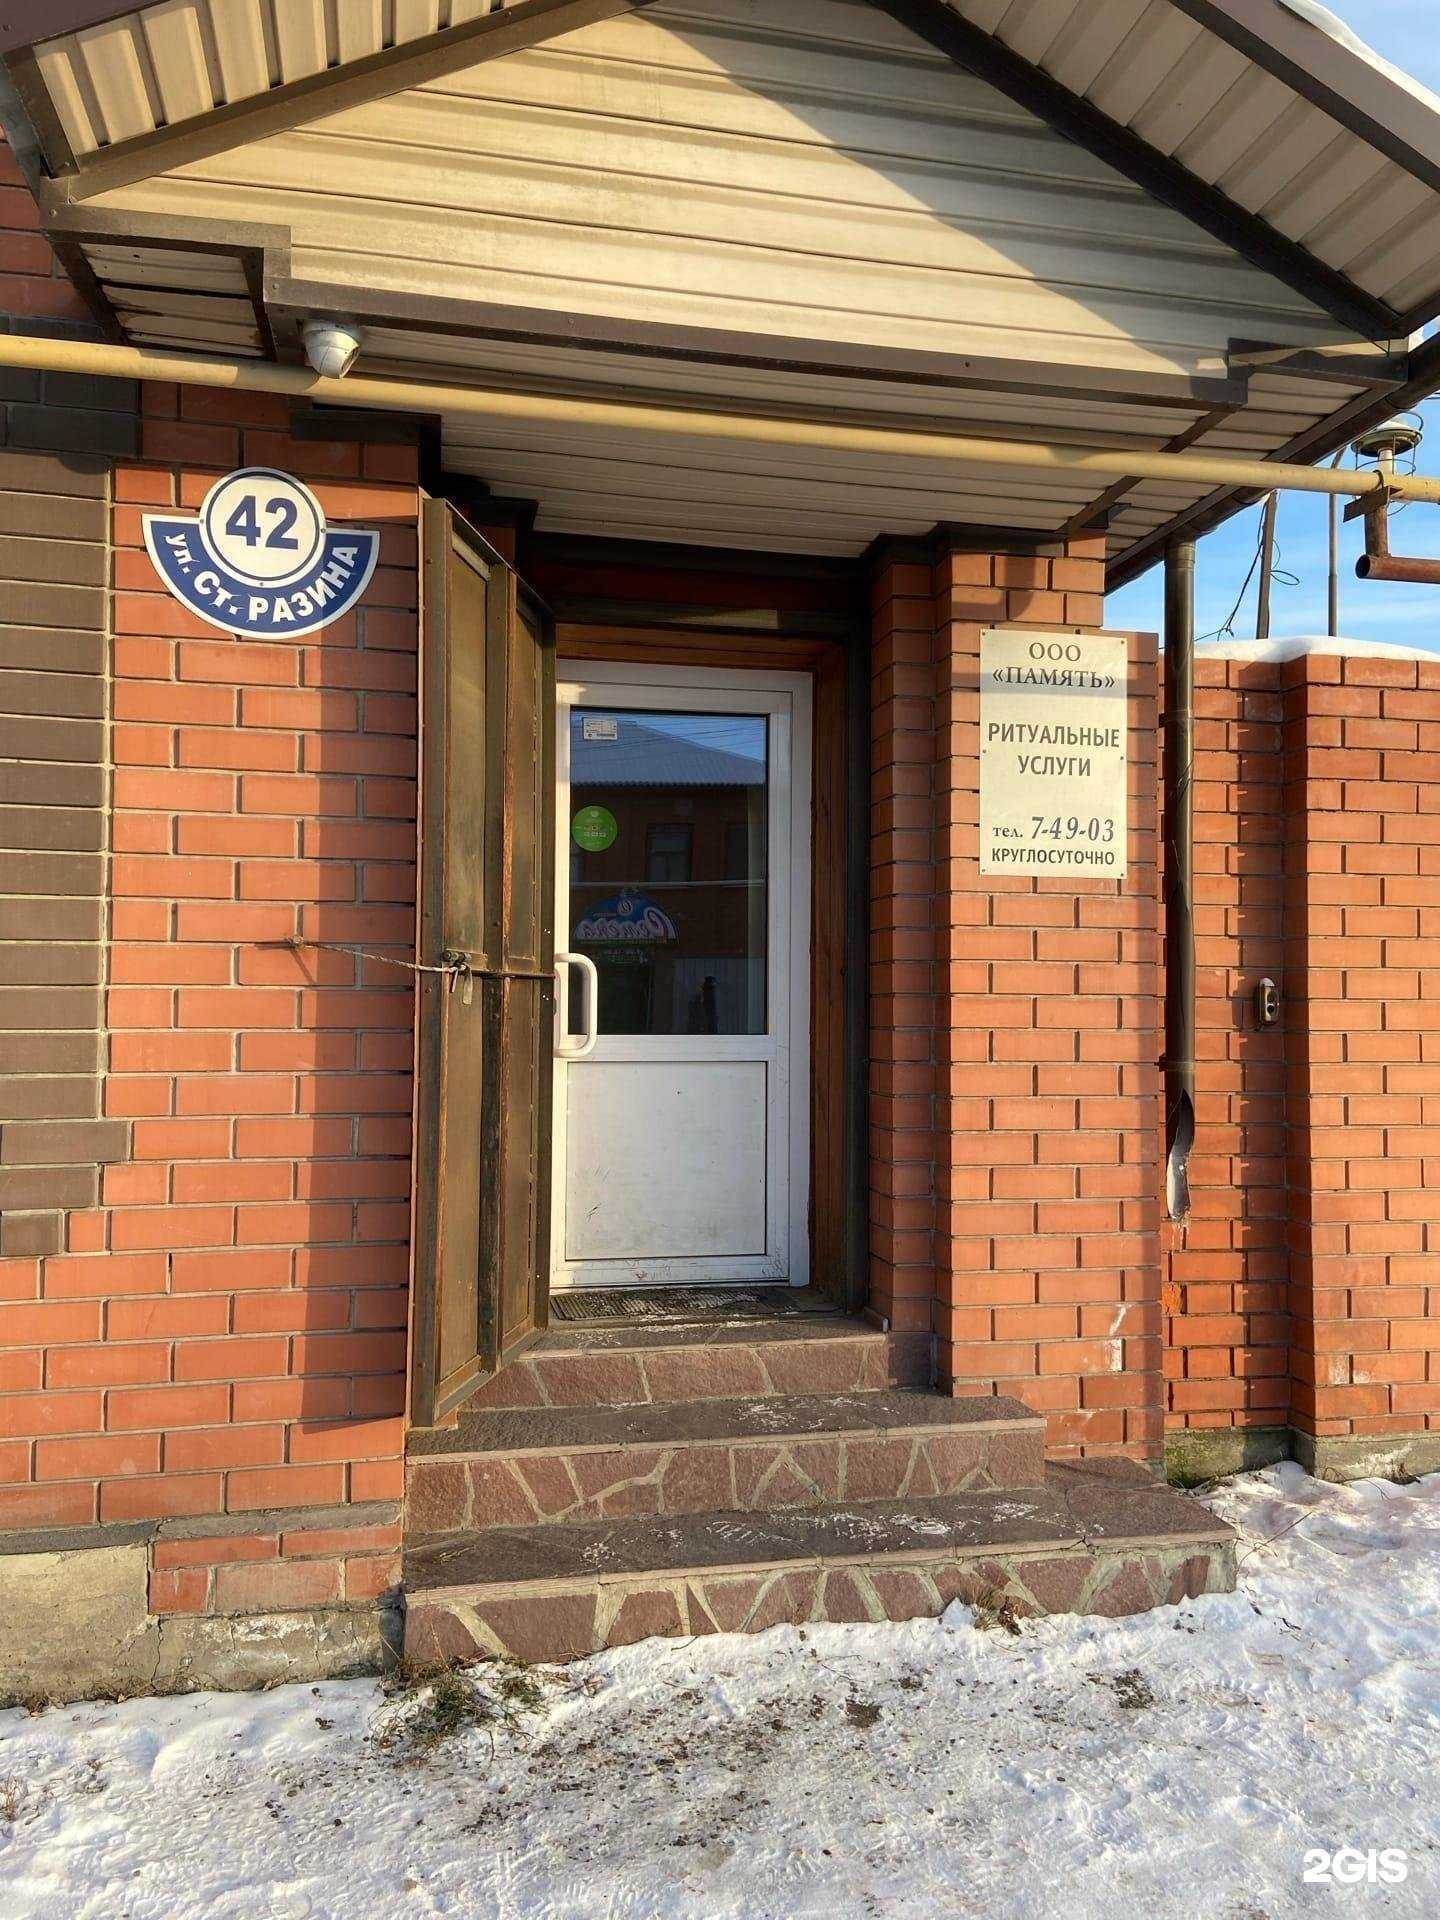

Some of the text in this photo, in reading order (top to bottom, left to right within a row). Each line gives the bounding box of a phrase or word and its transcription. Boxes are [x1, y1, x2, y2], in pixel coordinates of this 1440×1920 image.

[225, 495, 299, 550] 42
[165, 533, 199, 574] ул.
[247, 546, 359, 623] РАЗИНА
[1029, 642, 1081, 662] ООО
[992, 666, 1116, 689] «ПАМЯТЬ»
[988, 722, 1120, 748] РИТУАЛЬНЫЕ
[1018, 755, 1091, 777] УСЛУГИ
[992, 816, 1114, 842] тел. 7-49-03
[992, 847, 1115, 866] КРУГЛОСУТОЧНО
